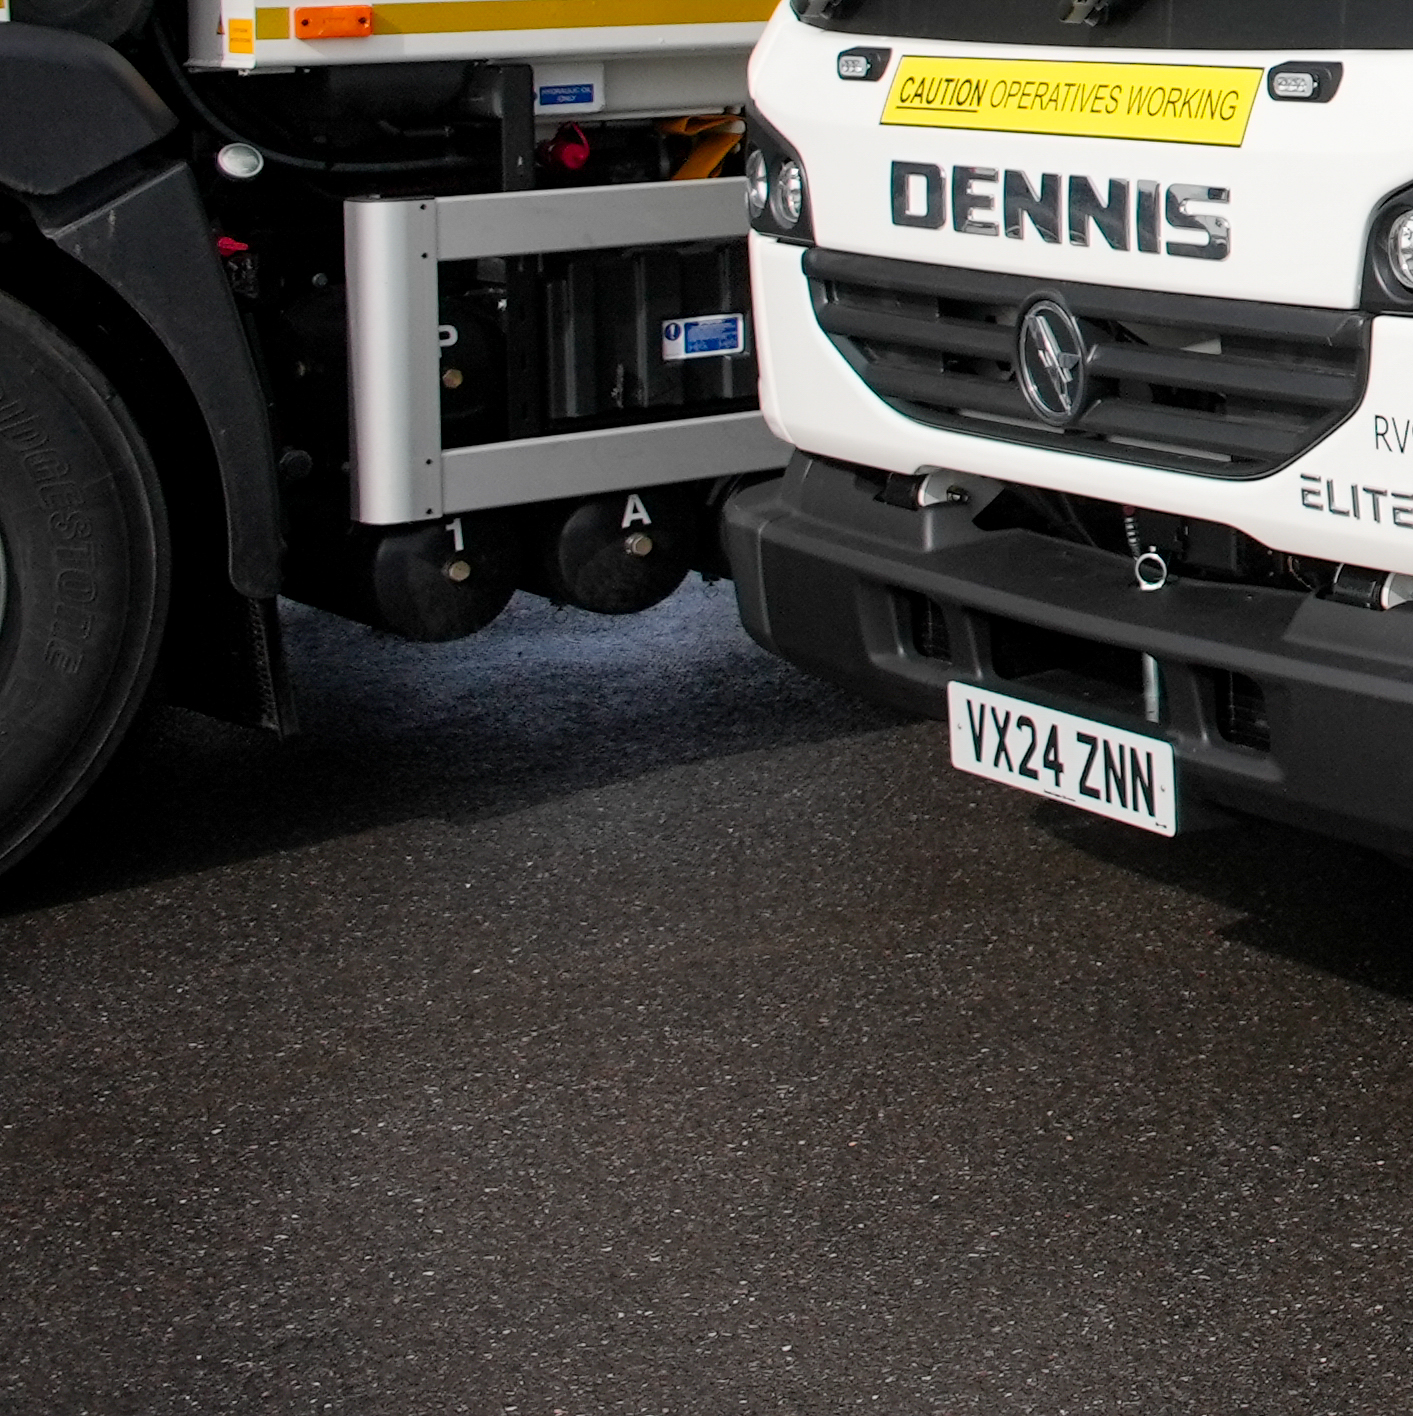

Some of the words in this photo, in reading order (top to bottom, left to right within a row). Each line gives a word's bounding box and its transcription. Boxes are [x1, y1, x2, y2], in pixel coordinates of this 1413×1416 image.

[898, 77, 988, 107] CAUTION
[990, 79, 1121, 114] OPERATIVES
[1126, 85, 1240, 121] WORKING
[891, 160, 1232, 261] DENNIS
[621, 494, 662, 529] A
[445, 517, 464, 552] 1
[966, 699, 1065, 788] VX24
[1076, 731, 1156, 818] ZNN
